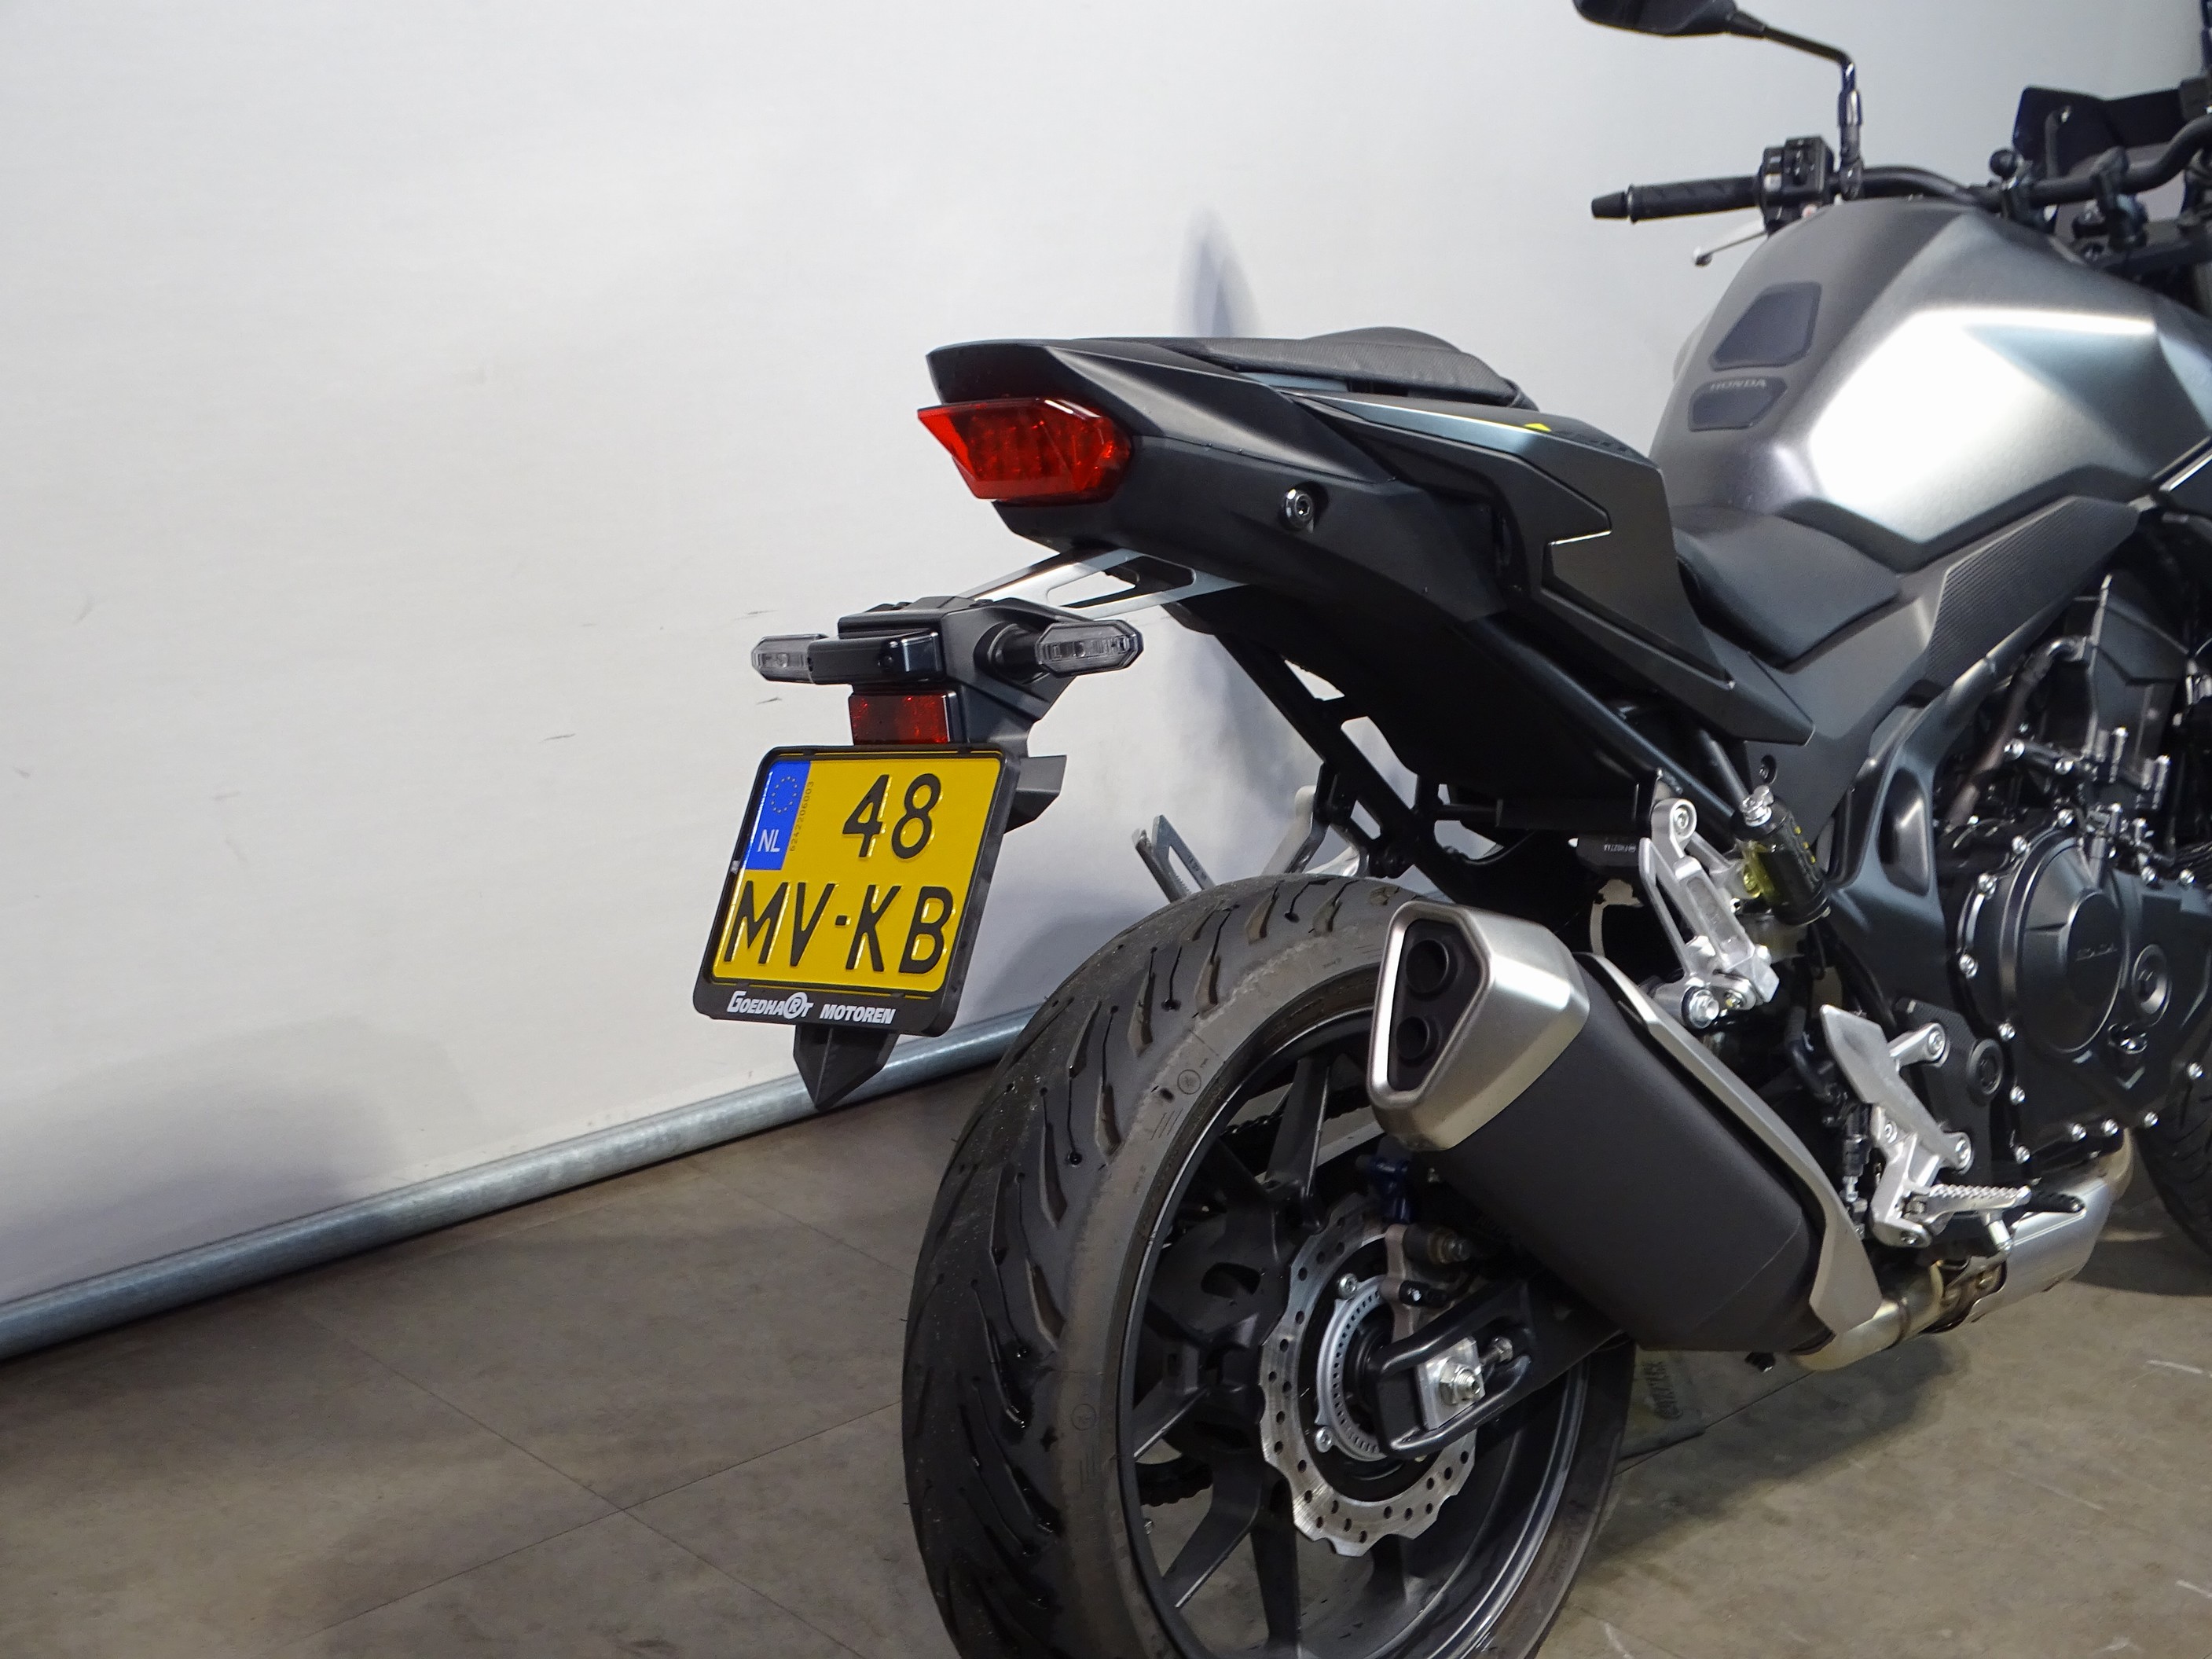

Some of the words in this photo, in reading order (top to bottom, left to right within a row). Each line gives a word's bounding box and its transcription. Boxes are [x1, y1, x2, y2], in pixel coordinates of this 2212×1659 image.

[758, 828, 780, 853] NL
[842, 773, 941, 859] 48
[723, 880, 954, 974] MV-KB
[819, 1004, 896, 1025] MOTOREN
